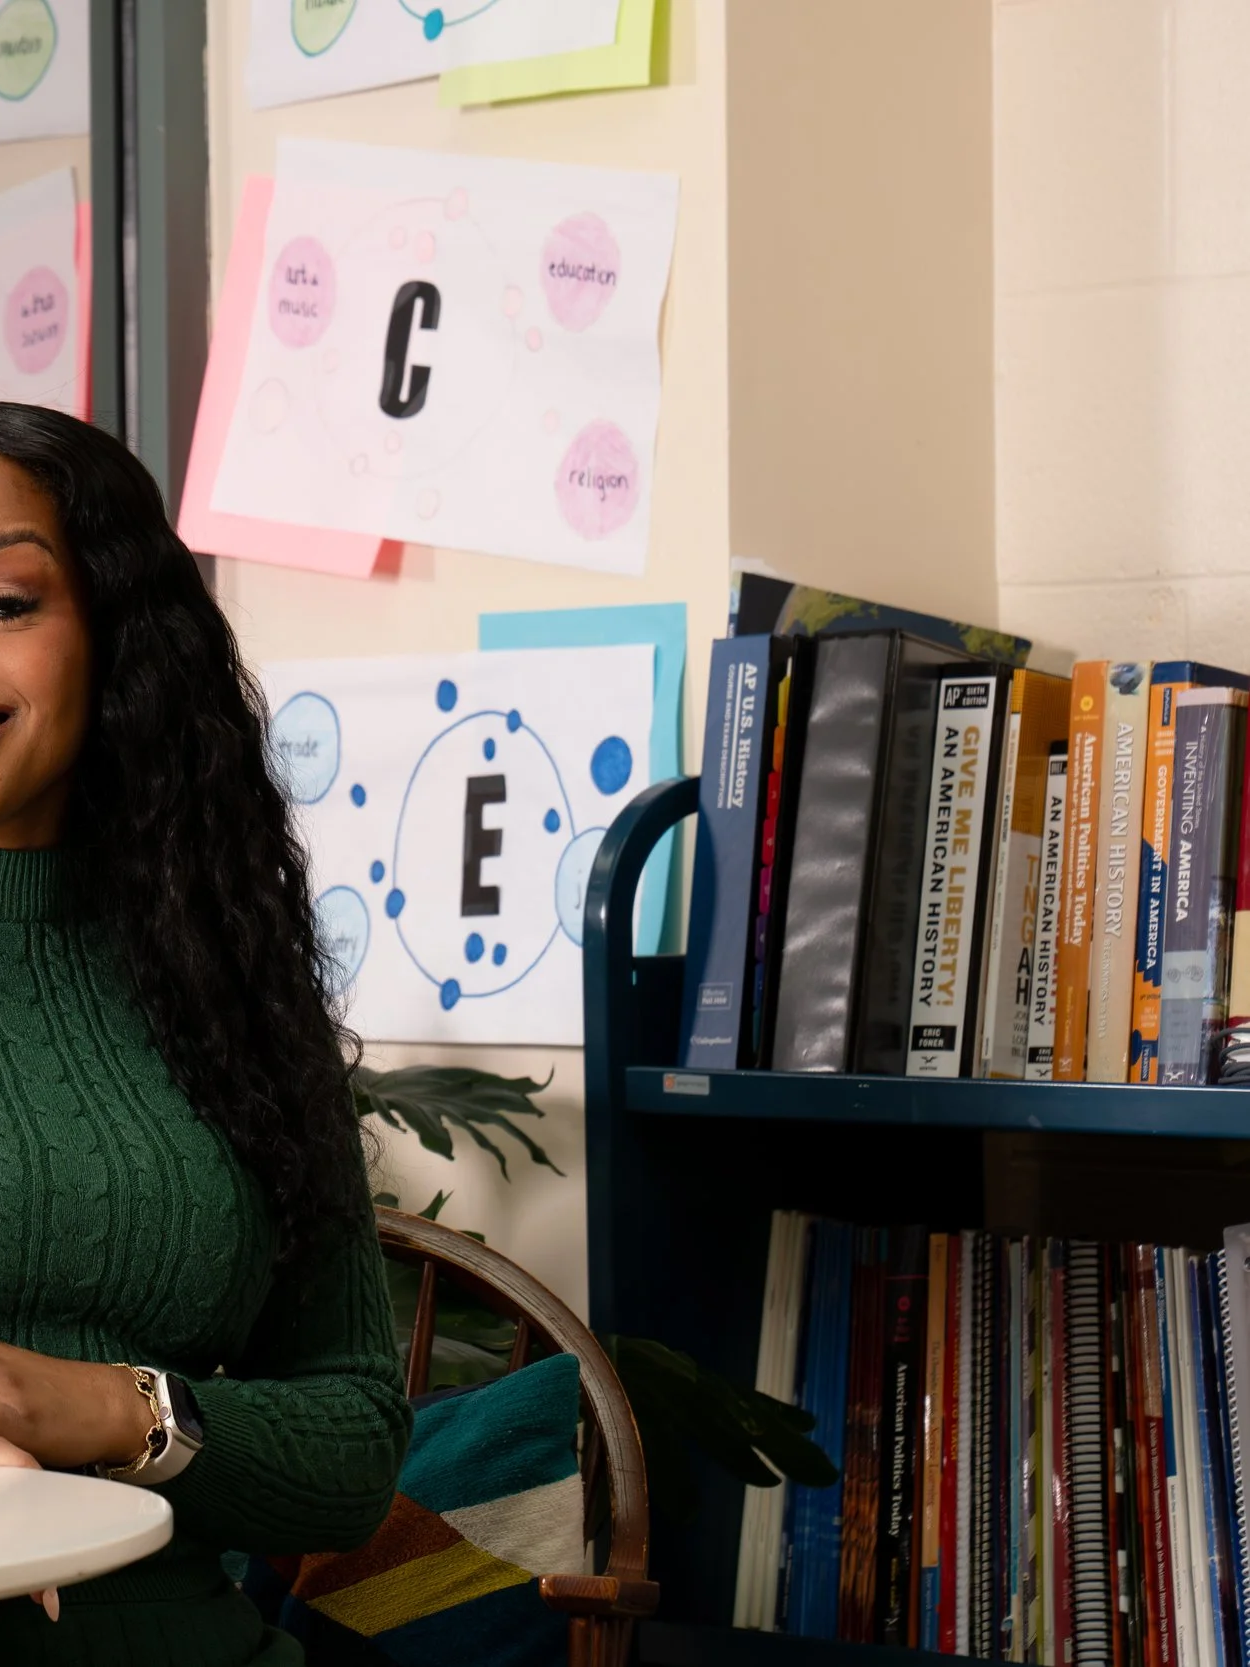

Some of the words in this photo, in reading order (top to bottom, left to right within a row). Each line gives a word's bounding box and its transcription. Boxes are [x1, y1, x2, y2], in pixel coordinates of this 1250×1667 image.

[548, 257, 616, 285] education
[278, 297, 318, 318] music
[379, 280, 441, 419] C
[569, 468, 629, 502] religion
[725, 664, 736, 700] COURSE
[744, 663, 758, 690] AP
[723, 702, 732, 720] AND
[945, 687, 960, 706] AP
[962, 696, 987, 706] EDITION
[739, 696, 755, 734] U.S.
[1200, 725, 1207, 733] A
[722, 722, 731, 748] EXAM
[943, 727, 959, 758] AN
[1197, 735, 1205, 759] History
[717, 749, 729, 808] DESCRIPTION
[732, 738, 751, 808] History
[957, 726, 981, 798] GIVE
[1080, 732, 1097, 818] American
[1110, 722, 1134, 837] AMERICAN
[1197, 771, 1205, 781] the
[1198, 761, 1205, 769] of
[1180, 742, 1198, 834] INVENTING
[1050, 796, 1062, 822] AN
[1152, 765, 1168, 871] GOVERNMENT
[1194, 807, 1202, 828] States
[460, 774, 506, 918] E
[930, 767, 954, 893] AMERICAN
[951, 809, 973, 856] ME
[1068, 825, 1077, 872] Government
[1076, 823, 1092, 889] Politics
[1041, 829, 1059, 933] AMERICAN
[1105, 843, 1126, 939] HISTORY
[1151, 876, 1161, 893] IN
[1175, 840, 1192, 922] AMERICA
[1065, 889, 1073, 918] Politics
[1069, 892, 1088, 948] Today
[936, 866, 967, 1007] LIBERTY!
[1146, 898, 1160, 969] AMERICA
[918, 903, 940, 1008] HISTORY
[1101, 940, 1112, 1000] BEGINNINGS
[1034, 940, 1051, 1026] HISTORY
[918, 1038, 944, 1048] FONER
[922, 1028, 941, 1037] ERIC
[1141, 1047, 1150, 1079] PEARSON
[894, 1361, 908, 1432] American
[893, 1435, 907, 1490] Politics
[1150, 1456, 1159, 1489] Historical
[887, 1493, 903, 1538] Today
[1153, 1490, 1161, 1520] Research
[1153, 1522, 1163, 1549] Through
[1157, 1562, 1165, 1591] National
[1157, 1592, 1167, 1617] History
[1159, 1619, 1168, 1632] Day
[1159, 1633, 1169, 1662] Program
